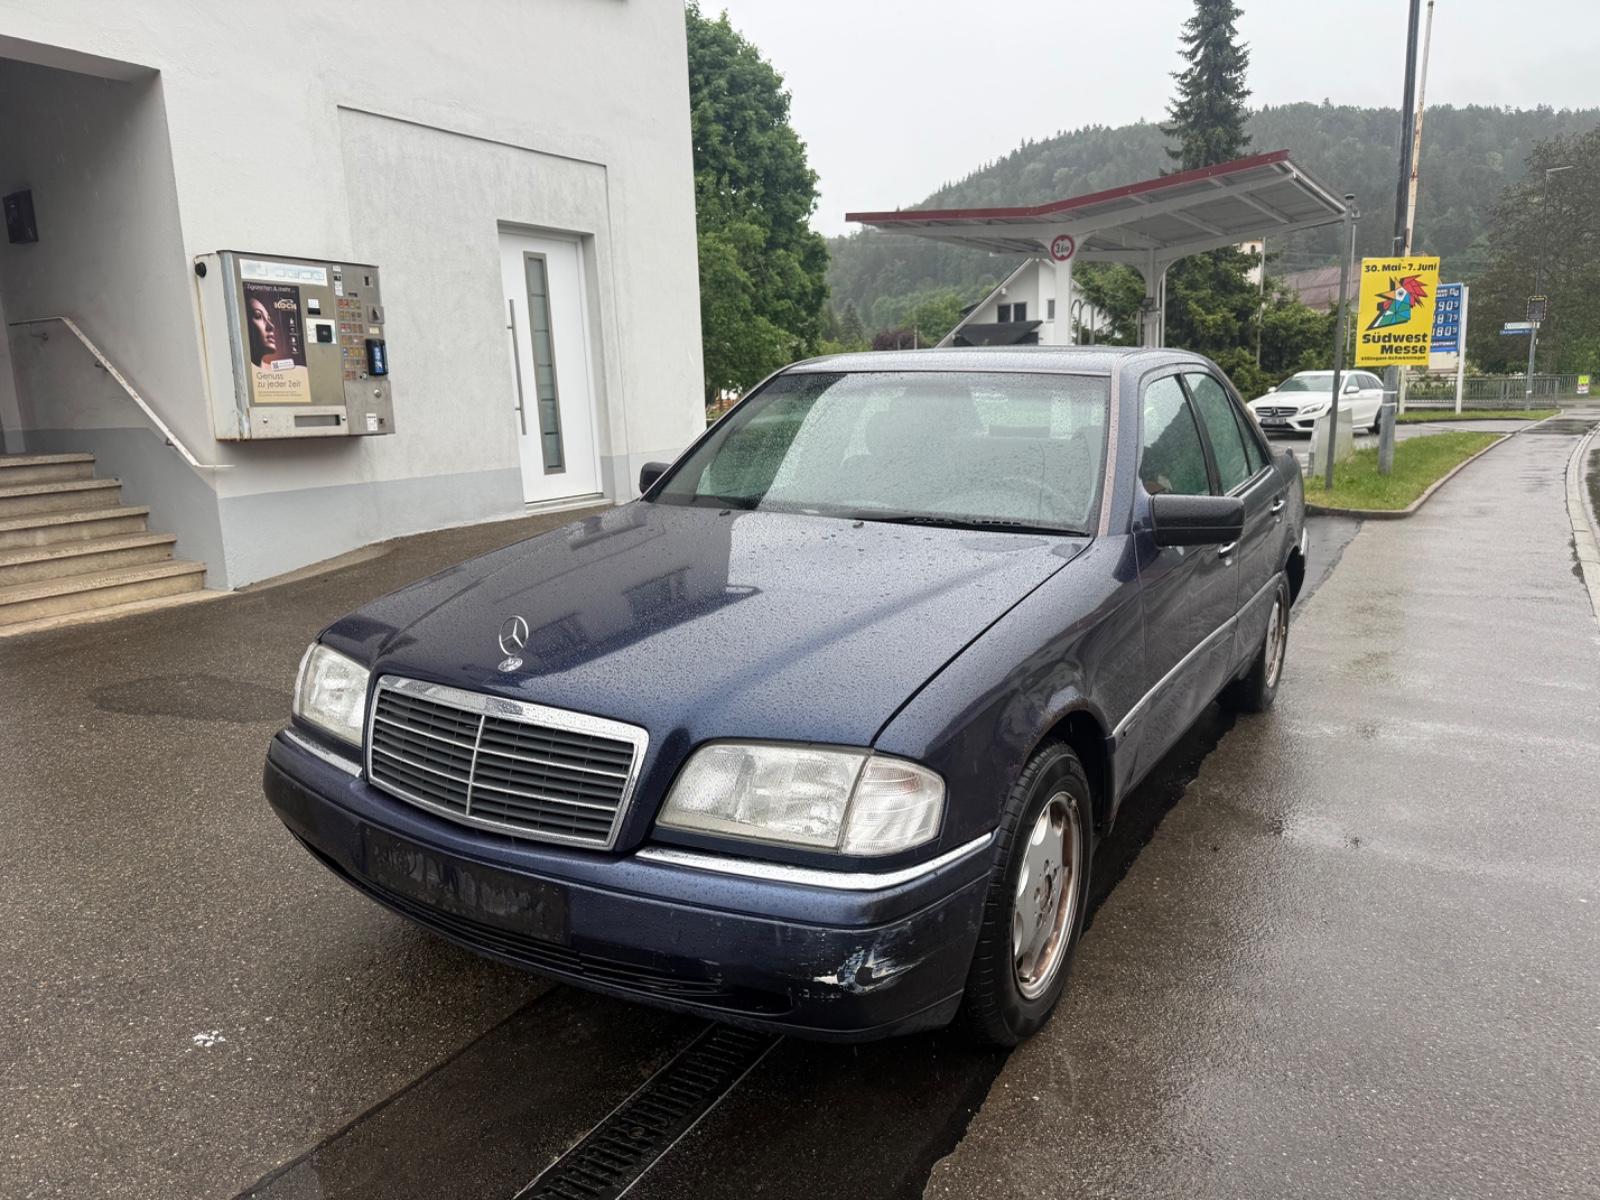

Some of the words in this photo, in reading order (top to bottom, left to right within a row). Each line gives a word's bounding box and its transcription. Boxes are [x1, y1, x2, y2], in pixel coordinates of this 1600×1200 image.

[1365, 264, 1380, 272] 30.
[1417, 262, 1437, 271] Juni
[1362, 331, 1428, 344] Südwest
[1381, 344, 1426, 355] Messe
[256, 371, 284, 380] Genuss
[267, 380, 286, 390] jeder
[288, 380, 301, 388] Zeit
